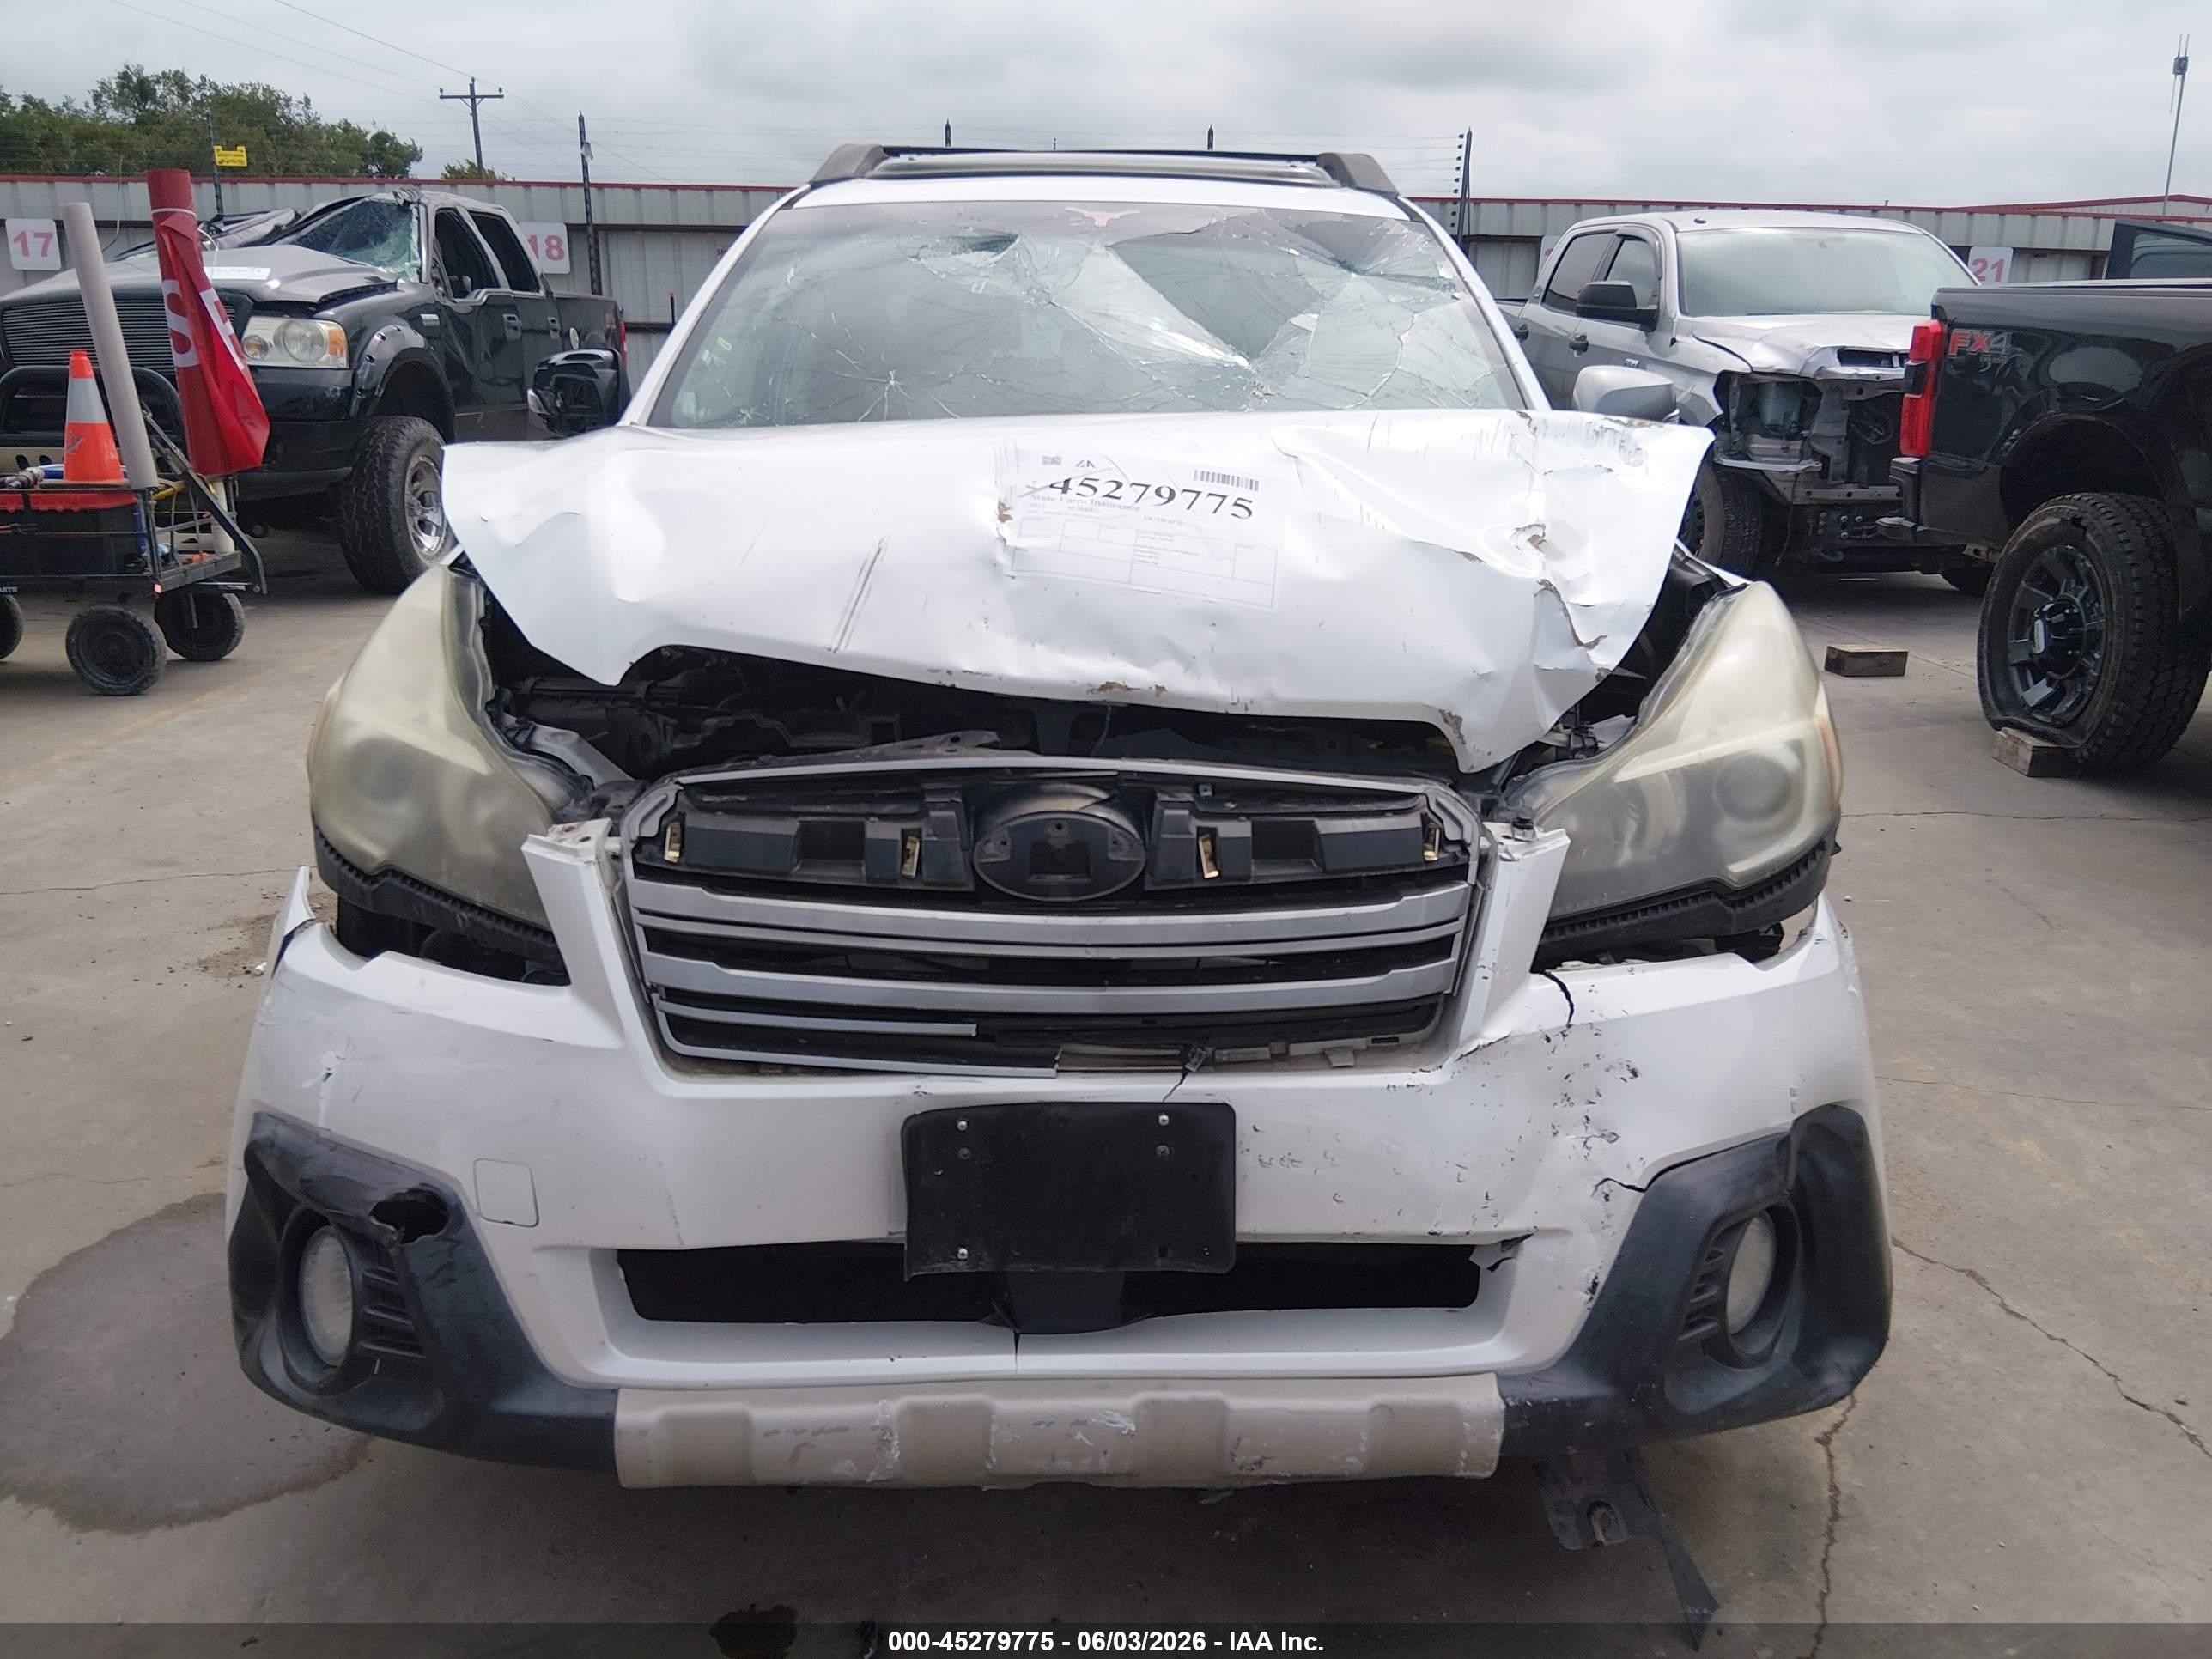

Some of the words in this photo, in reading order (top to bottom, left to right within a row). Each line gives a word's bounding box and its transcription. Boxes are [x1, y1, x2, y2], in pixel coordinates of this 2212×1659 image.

[13, 230, 53, 258] 17
[526, 234, 565, 261] 18
[1971, 258, 2006, 283] 21
[1947, 329, 2013, 358] FX4
[1030, 494, 1056, 503] State
[1049, 477, 1254, 520] 45279775
